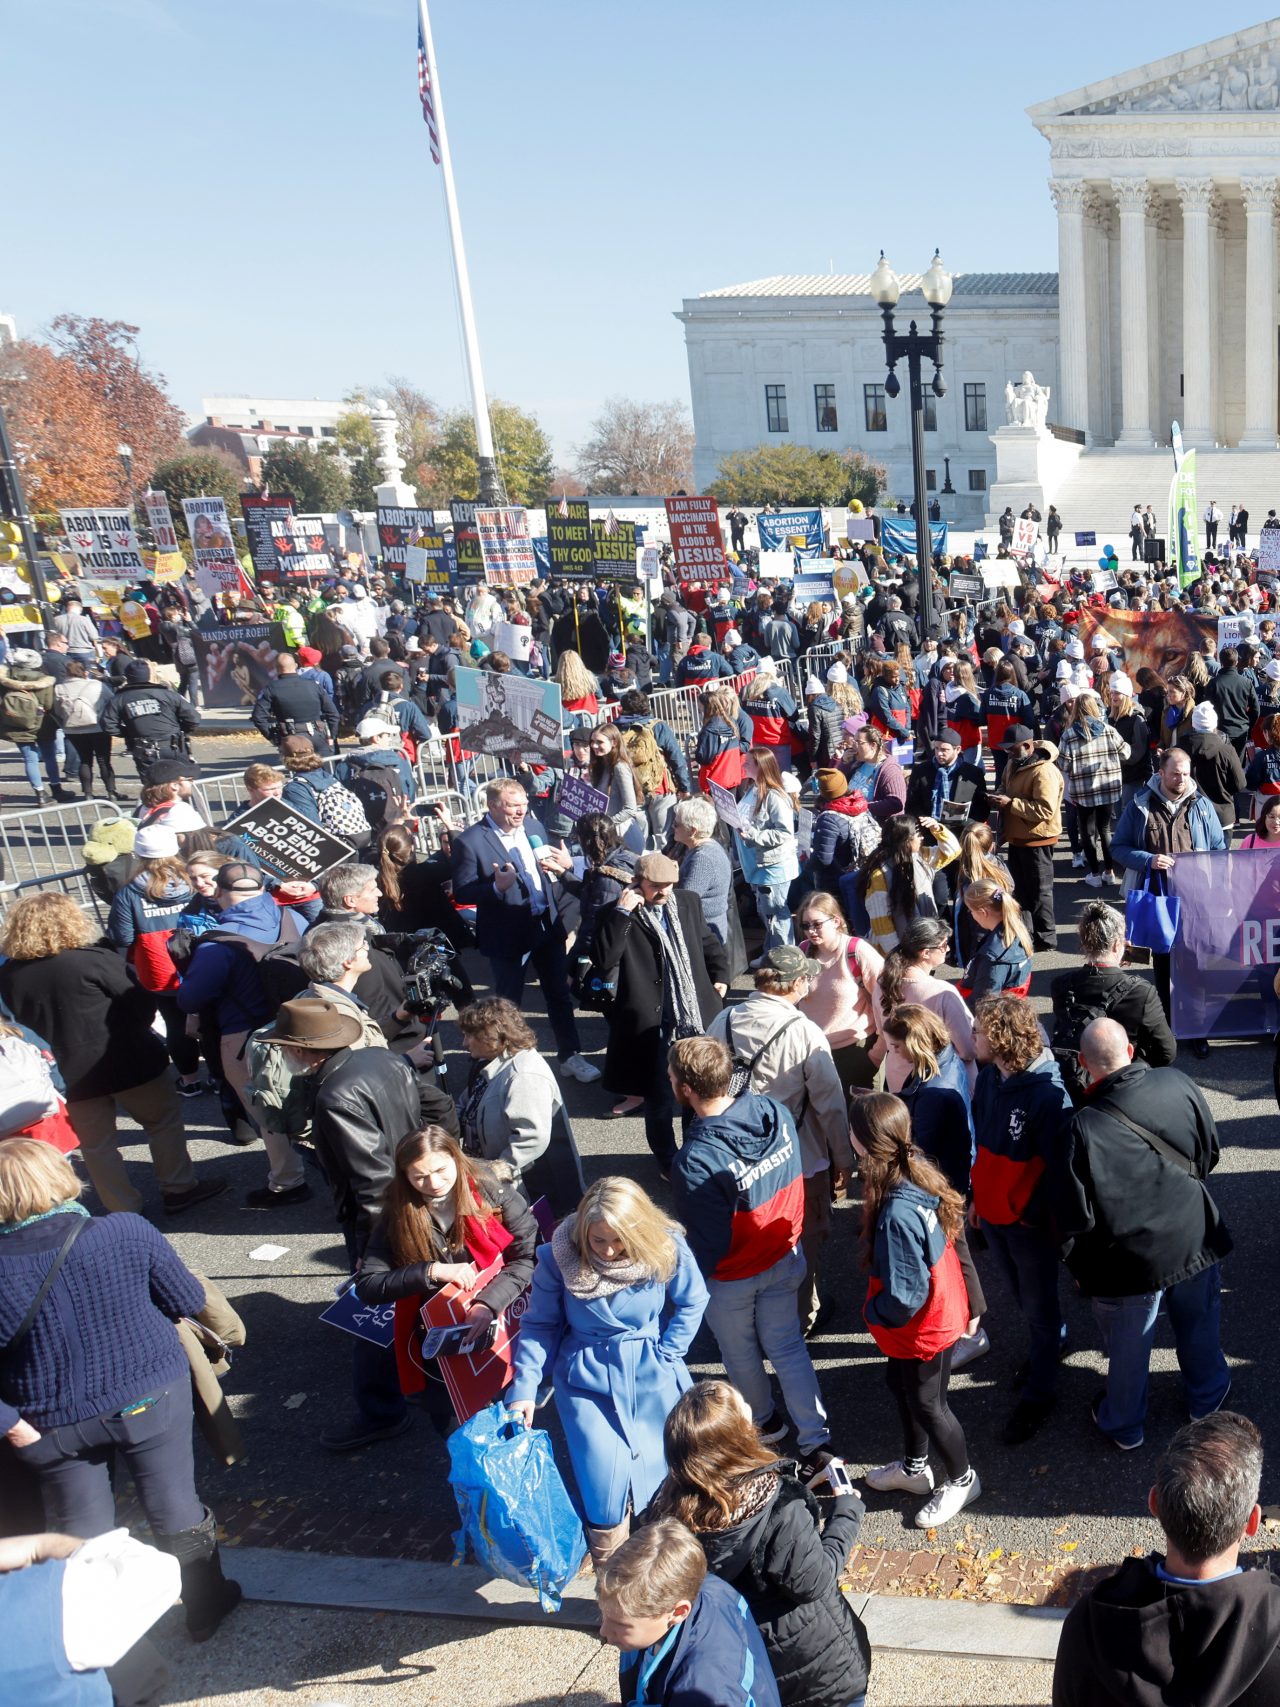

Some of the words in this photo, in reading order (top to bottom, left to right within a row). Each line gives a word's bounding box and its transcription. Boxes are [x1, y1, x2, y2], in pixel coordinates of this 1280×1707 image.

[185, 502, 224, 514] ABORTION
[670, 502, 674, 511] I
[676, 501, 688, 511] AM
[689, 500, 711, 510] FULLY
[66, 516, 132, 532] ABORTION
[378, 509, 434, 527] ABORTION
[669, 512, 716, 523] VACCINATED
[764, 516, 808, 527] ABORTION
[552, 526, 564, 540] TO
[566, 526, 588, 540] MEET
[683, 525, 692, 534] IN
[693, 524, 708, 534] THE
[766, 527, 774, 535] IS
[776, 524, 819, 535] ESSENTIAL
[97, 535, 112, 550] IS
[294, 538, 308, 553] IS
[678, 537, 704, 546] BLOOD
[706, 536, 715, 546] OF
[196, 548, 234, 558] DOMESTIC
[552, 548, 569, 562] THY
[571, 548, 592, 562] GOD
[594, 542, 636, 560] JESUS
[677, 548, 724, 563] JESUS
[78, 552, 142, 568] MURDER
[278, 554, 332, 571] MURDER
[486, 562, 535, 570] HOMOSEXUALS
[680, 564, 726, 580] CHRIST
[202, 630, 227, 642] HANDS
[229, 629, 244, 640] OFF
[245, 627, 270, 639] ROE!!!
[128, 705, 161, 718] POLICE
[560, 788, 603, 813] POST-RO
[571, 784, 585, 798] AM
[588, 793, 604, 809] THE
[283, 816, 326, 843] PRAY
[265, 818, 288, 836] TO
[286, 834, 320, 857] END
[240, 821, 322, 873] ABORTION
